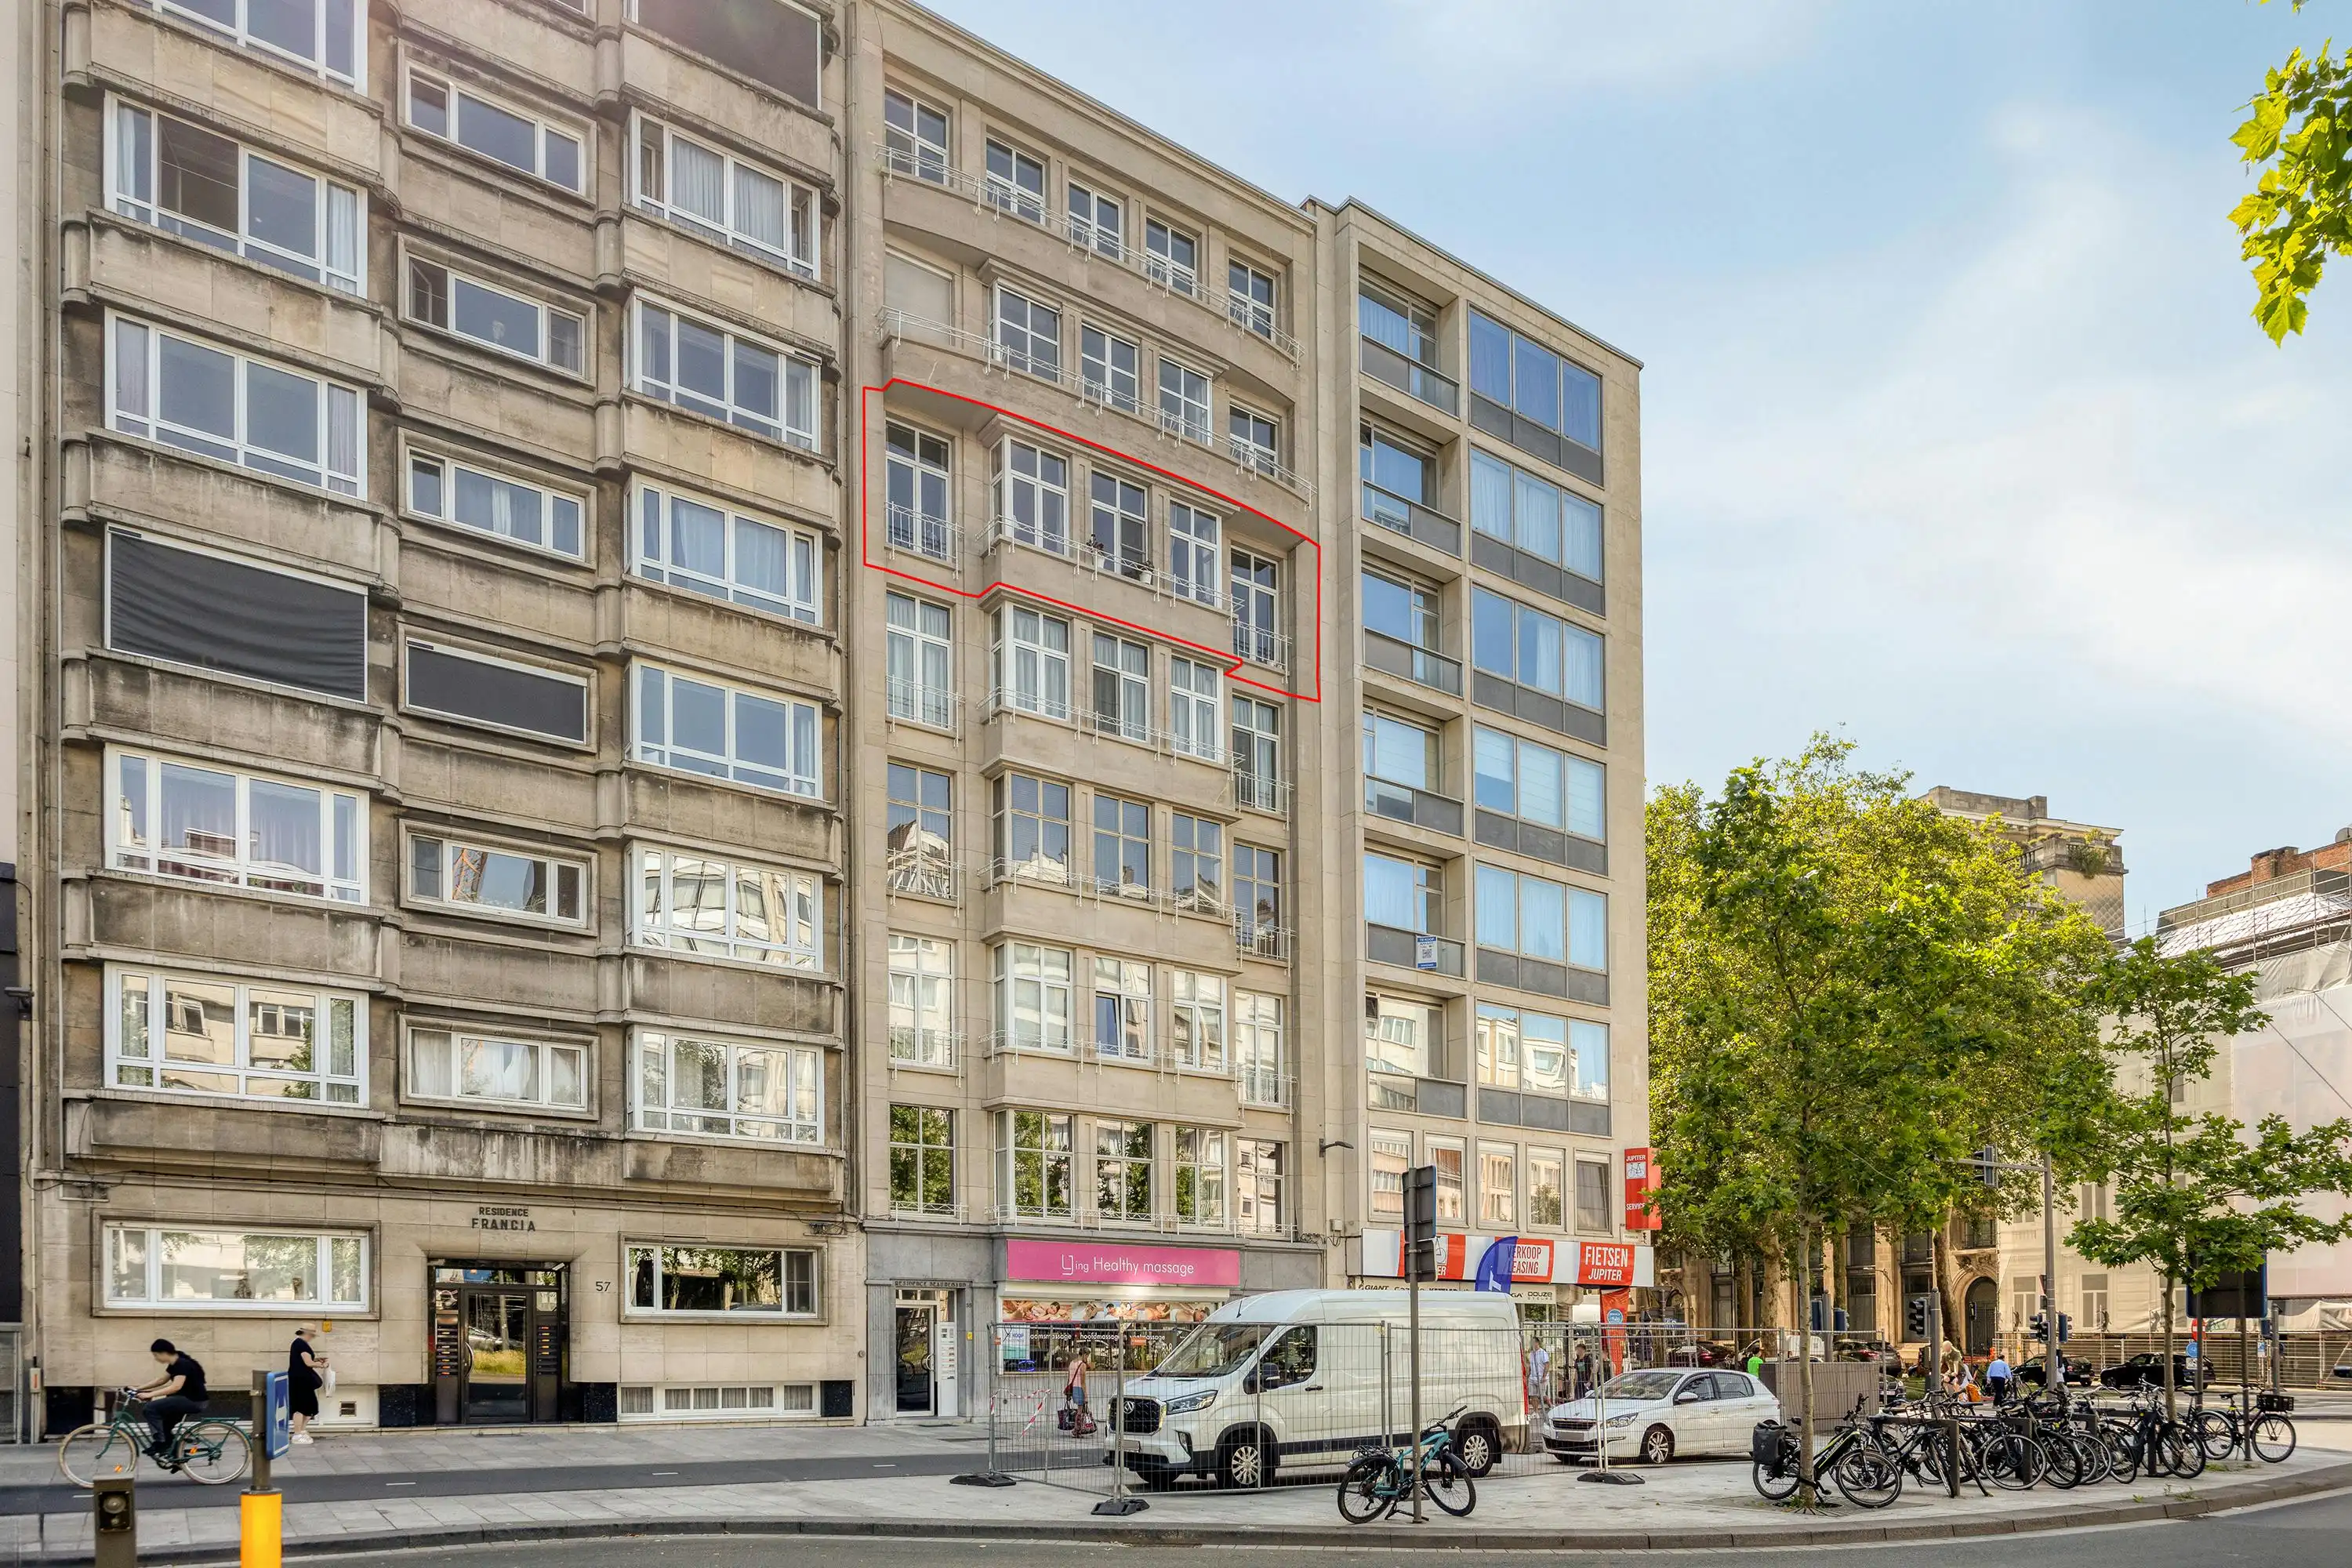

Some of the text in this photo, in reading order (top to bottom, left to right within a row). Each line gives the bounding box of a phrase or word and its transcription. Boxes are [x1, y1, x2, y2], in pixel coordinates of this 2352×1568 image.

[479, 1207, 528, 1217] RESIDENCE
[471, 1218, 535, 1232] FRANCIA
[1508, 1246, 1541, 1260] VERKOOP
[1585, 1246, 1628, 1267] FIETSEN
[1094, 1257, 1139, 1276] Healthy
[1143, 1262, 1194, 1277] massage
[1508, 1261, 1539, 1274] LEASING
[1588, 1268, 1622, 1281] JUPITER
[596, 1281, 611, 1292] 57
